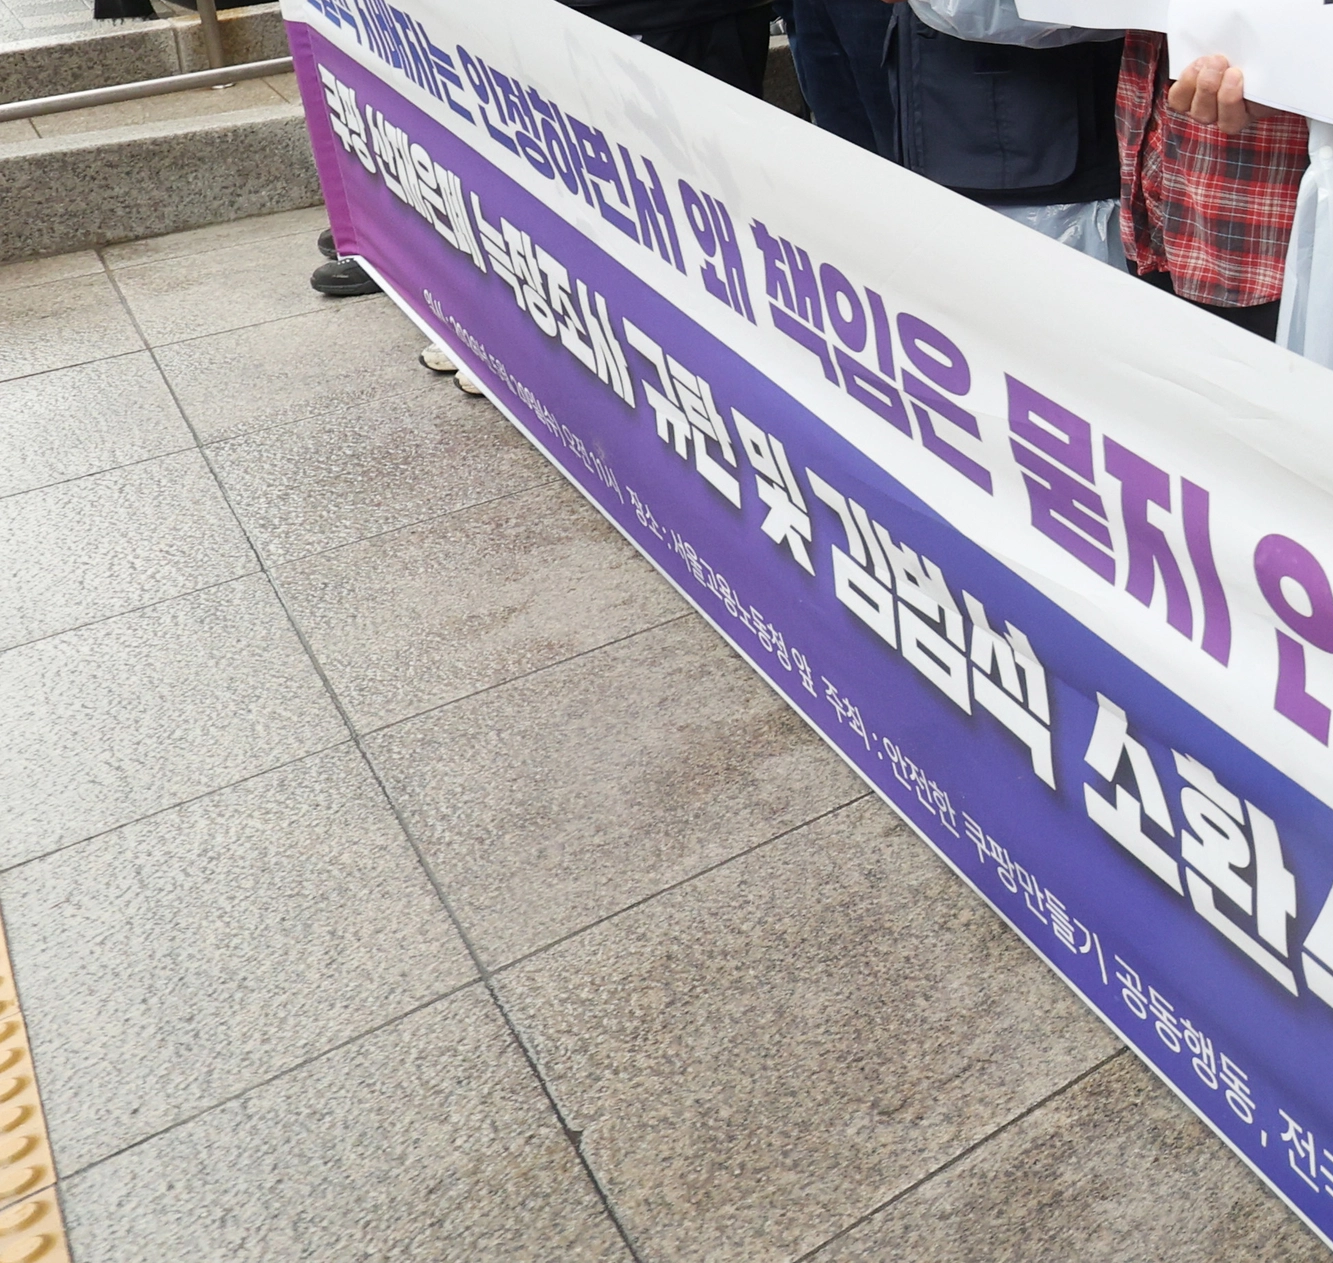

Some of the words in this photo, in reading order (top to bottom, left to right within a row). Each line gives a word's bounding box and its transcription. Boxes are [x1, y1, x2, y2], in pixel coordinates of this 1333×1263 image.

[318, 63, 377, 174] 쿠팡
[365, 104, 488, 274] 산재은폐
[470, 189, 636, 409] 늑장조사
[622, 316, 742, 510] 규탄
[731, 406, 816, 576] 및
[804, 465, 1057, 791] 김범석
[455, 44, 686, 276] 인정하면서
[677, 178, 758, 327] 왜
[749, 216, 994, 497] 책임은
[1003, 370, 1232, 669] 묻지
[562, 424, 595, 473] 오전
[791, 647, 817, 697] 앞
[964, 817, 1108, 985] 쿠팡만들기
